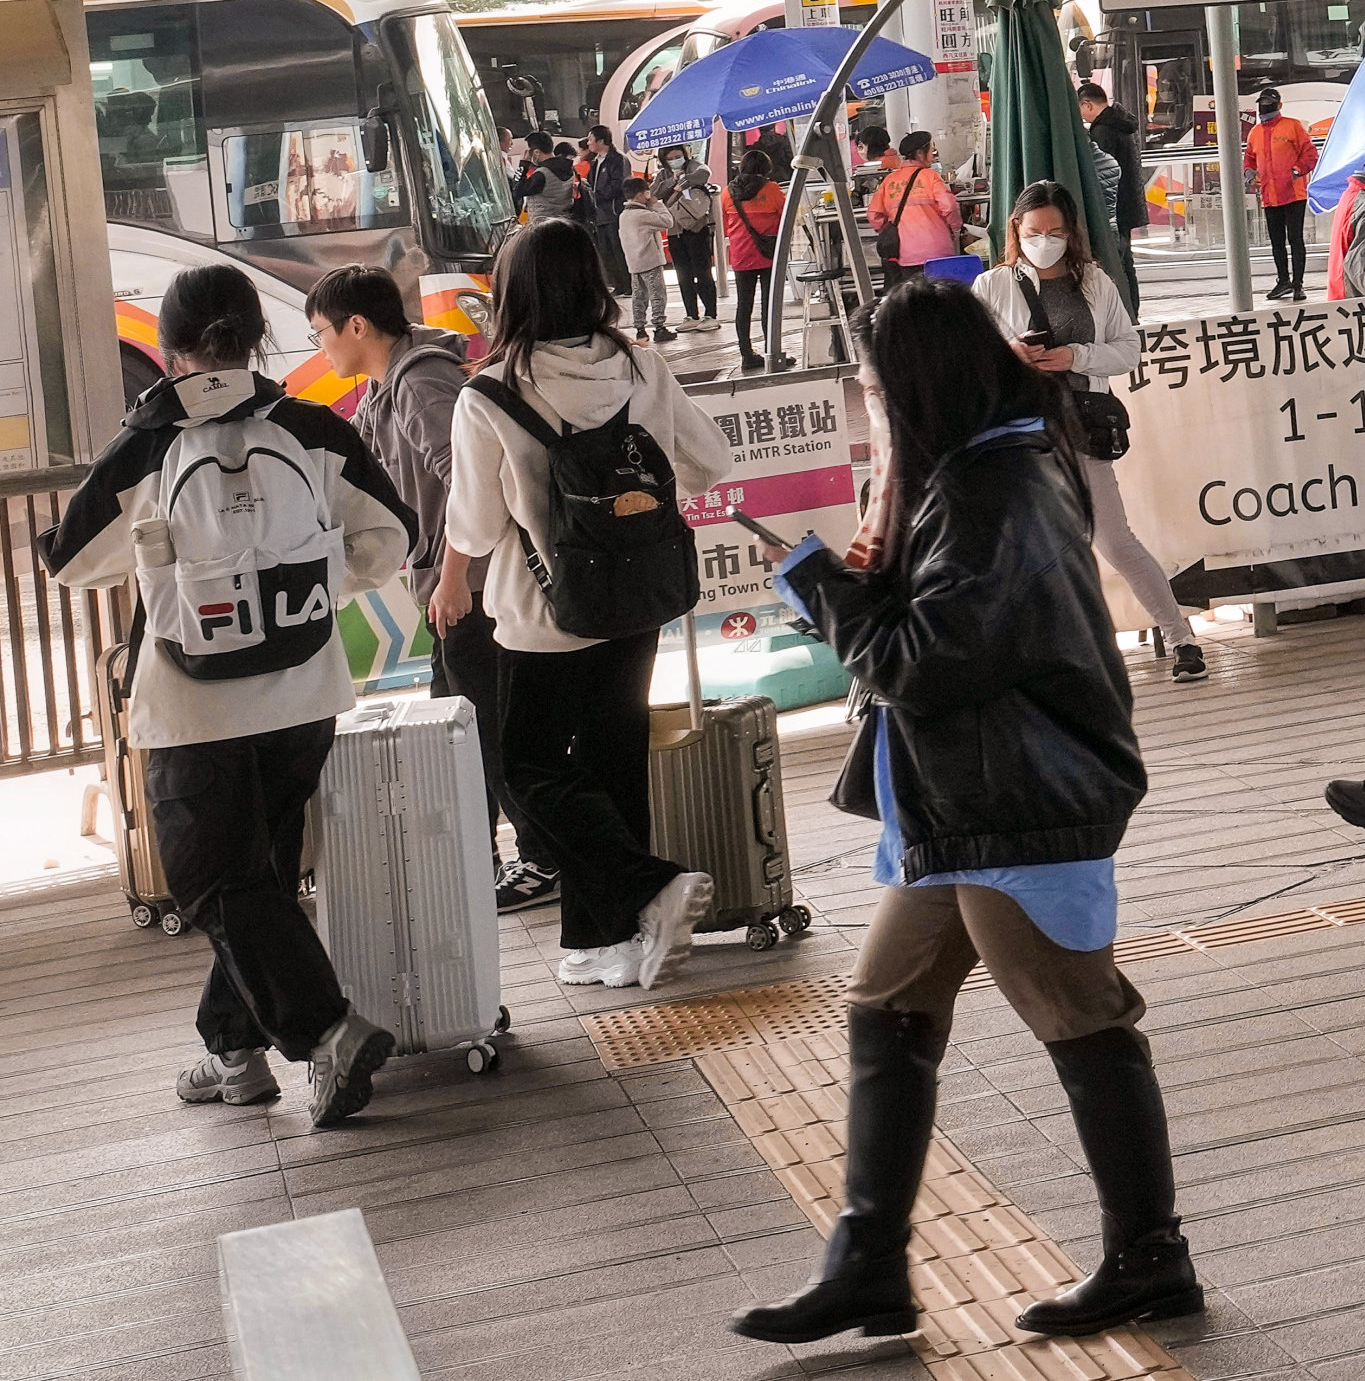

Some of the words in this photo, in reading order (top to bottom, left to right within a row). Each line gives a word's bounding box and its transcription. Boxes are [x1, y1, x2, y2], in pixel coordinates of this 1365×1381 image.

[766, 78, 817, 94] Chinalink
[650, 128, 667, 137] 2230
[203, 382, 230, 393] CAMEL
[750, 446, 781, 461] MTR
[784, 440, 832, 455] Station
[1199, 463, 1358, 526] Coach
[686, 513, 700, 522] Tin
[701, 511, 716, 520] Tsz
[719, 582, 759, 597] Town
[199, 582, 330, 642] FILA
